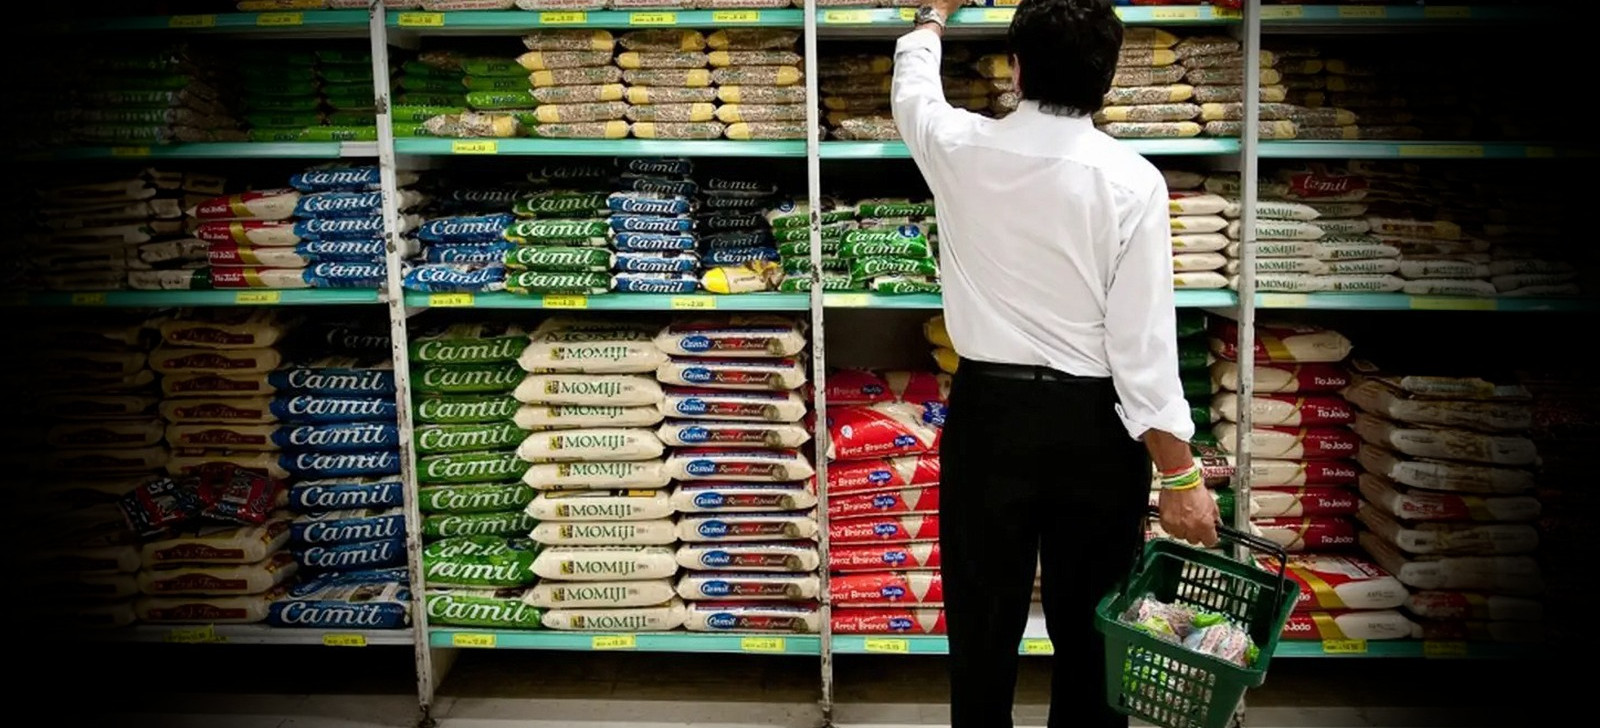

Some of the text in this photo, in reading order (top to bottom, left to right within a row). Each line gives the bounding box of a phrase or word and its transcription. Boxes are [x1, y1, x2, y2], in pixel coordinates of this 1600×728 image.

[302, 169, 371, 184] Camil
[1304, 174, 1350, 192] Camil
[304, 194, 380, 212] Camil
[527, 195, 601, 212] Camil
[622, 200, 678, 214] Camil
[307, 217, 384, 232] Camil
[431, 218, 502, 235] Camil
[516, 221, 596, 236] Camil
[624, 217, 680, 230] Camil
[307, 240, 383, 254] Camil
[627, 235, 683, 250] Camil
[852, 242, 912, 256] Camil
[516, 248, 594, 264] Camil
[626, 258, 682, 271] Camil
[865, 260, 919, 274] Camil
[417, 268, 490, 284] Camil
[518, 272, 594, 286] Camil
[629, 279, 684, 292] Camil
[419, 340, 515, 361] Camil
[566, 347, 628, 362] MOMIJI
[288, 369, 385, 390] Camil
[424, 367, 518, 386] Camil
[560, 382, 621, 398] MOMIJI
[288, 395, 386, 415] Camil
[419, 398, 512, 418] Camil
[290, 425, 388, 445] Camil
[420, 424, 514, 450] Camil
[565, 436, 625, 450] MOMIJI
[296, 452, 394, 470] Camil
[428, 454, 522, 478] Camil
[572, 463, 632, 478] MOMIJI
[300, 485, 394, 508] Camil
[432, 486, 527, 510] Camil
[571, 504, 631, 518] MOMIJI
[304, 518, 398, 544] Camil
[440, 512, 534, 537] Camil
[575, 525, 634, 540] MOMIJI
[304, 542, 394, 568] Camil
[576, 560, 636, 576] MOMIJI
[567, 587, 626, 602] MOMIJI
[280, 602, 383, 625] Camil
[428, 596, 530, 623] Camil
[587, 616, 646, 630] MOMIJI
